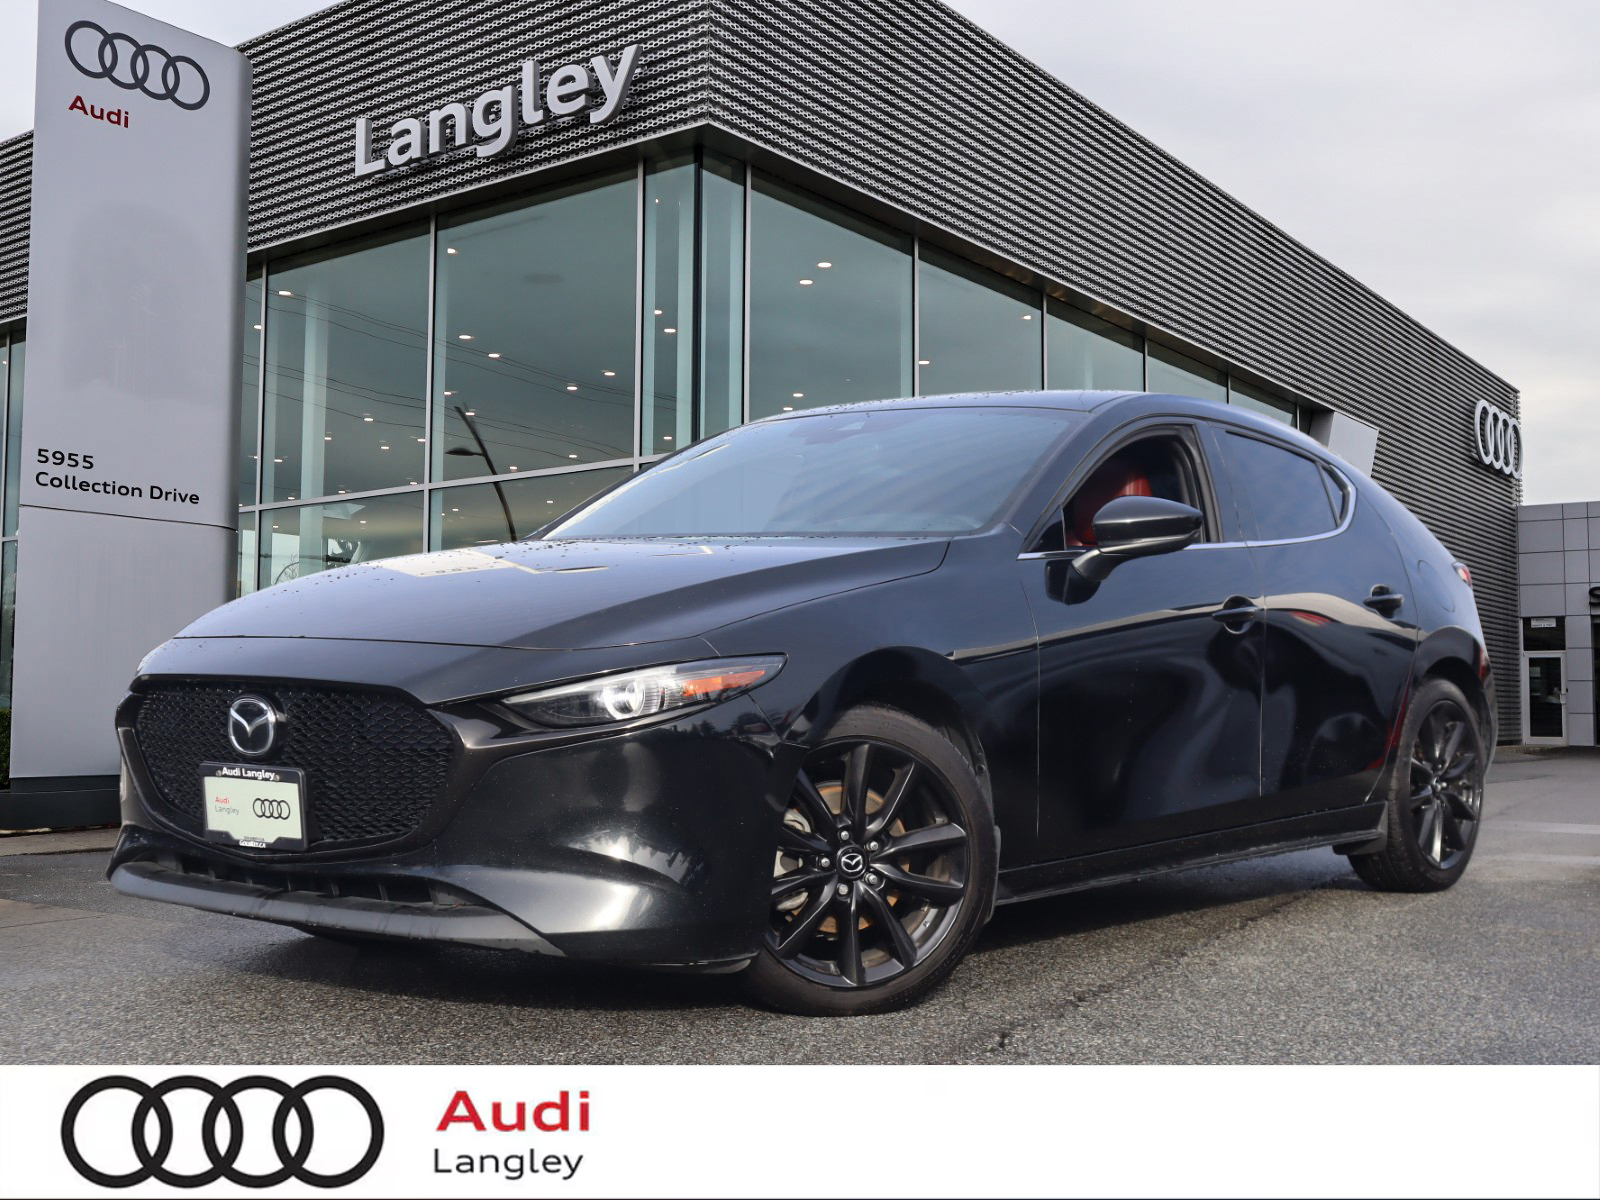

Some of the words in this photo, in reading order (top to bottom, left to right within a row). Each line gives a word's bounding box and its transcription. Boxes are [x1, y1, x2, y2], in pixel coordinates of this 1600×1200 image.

[69, 95, 129, 129] Audi
[355, 44, 642, 177] Langley
[37, 448, 94, 469] 5955
[35, 471, 143, 498] Collection
[149, 485, 200, 504] Drive
[222, 767, 241, 776] Audi
[242, 768, 275, 781] Langley
[215, 805, 240, 816] Langley
